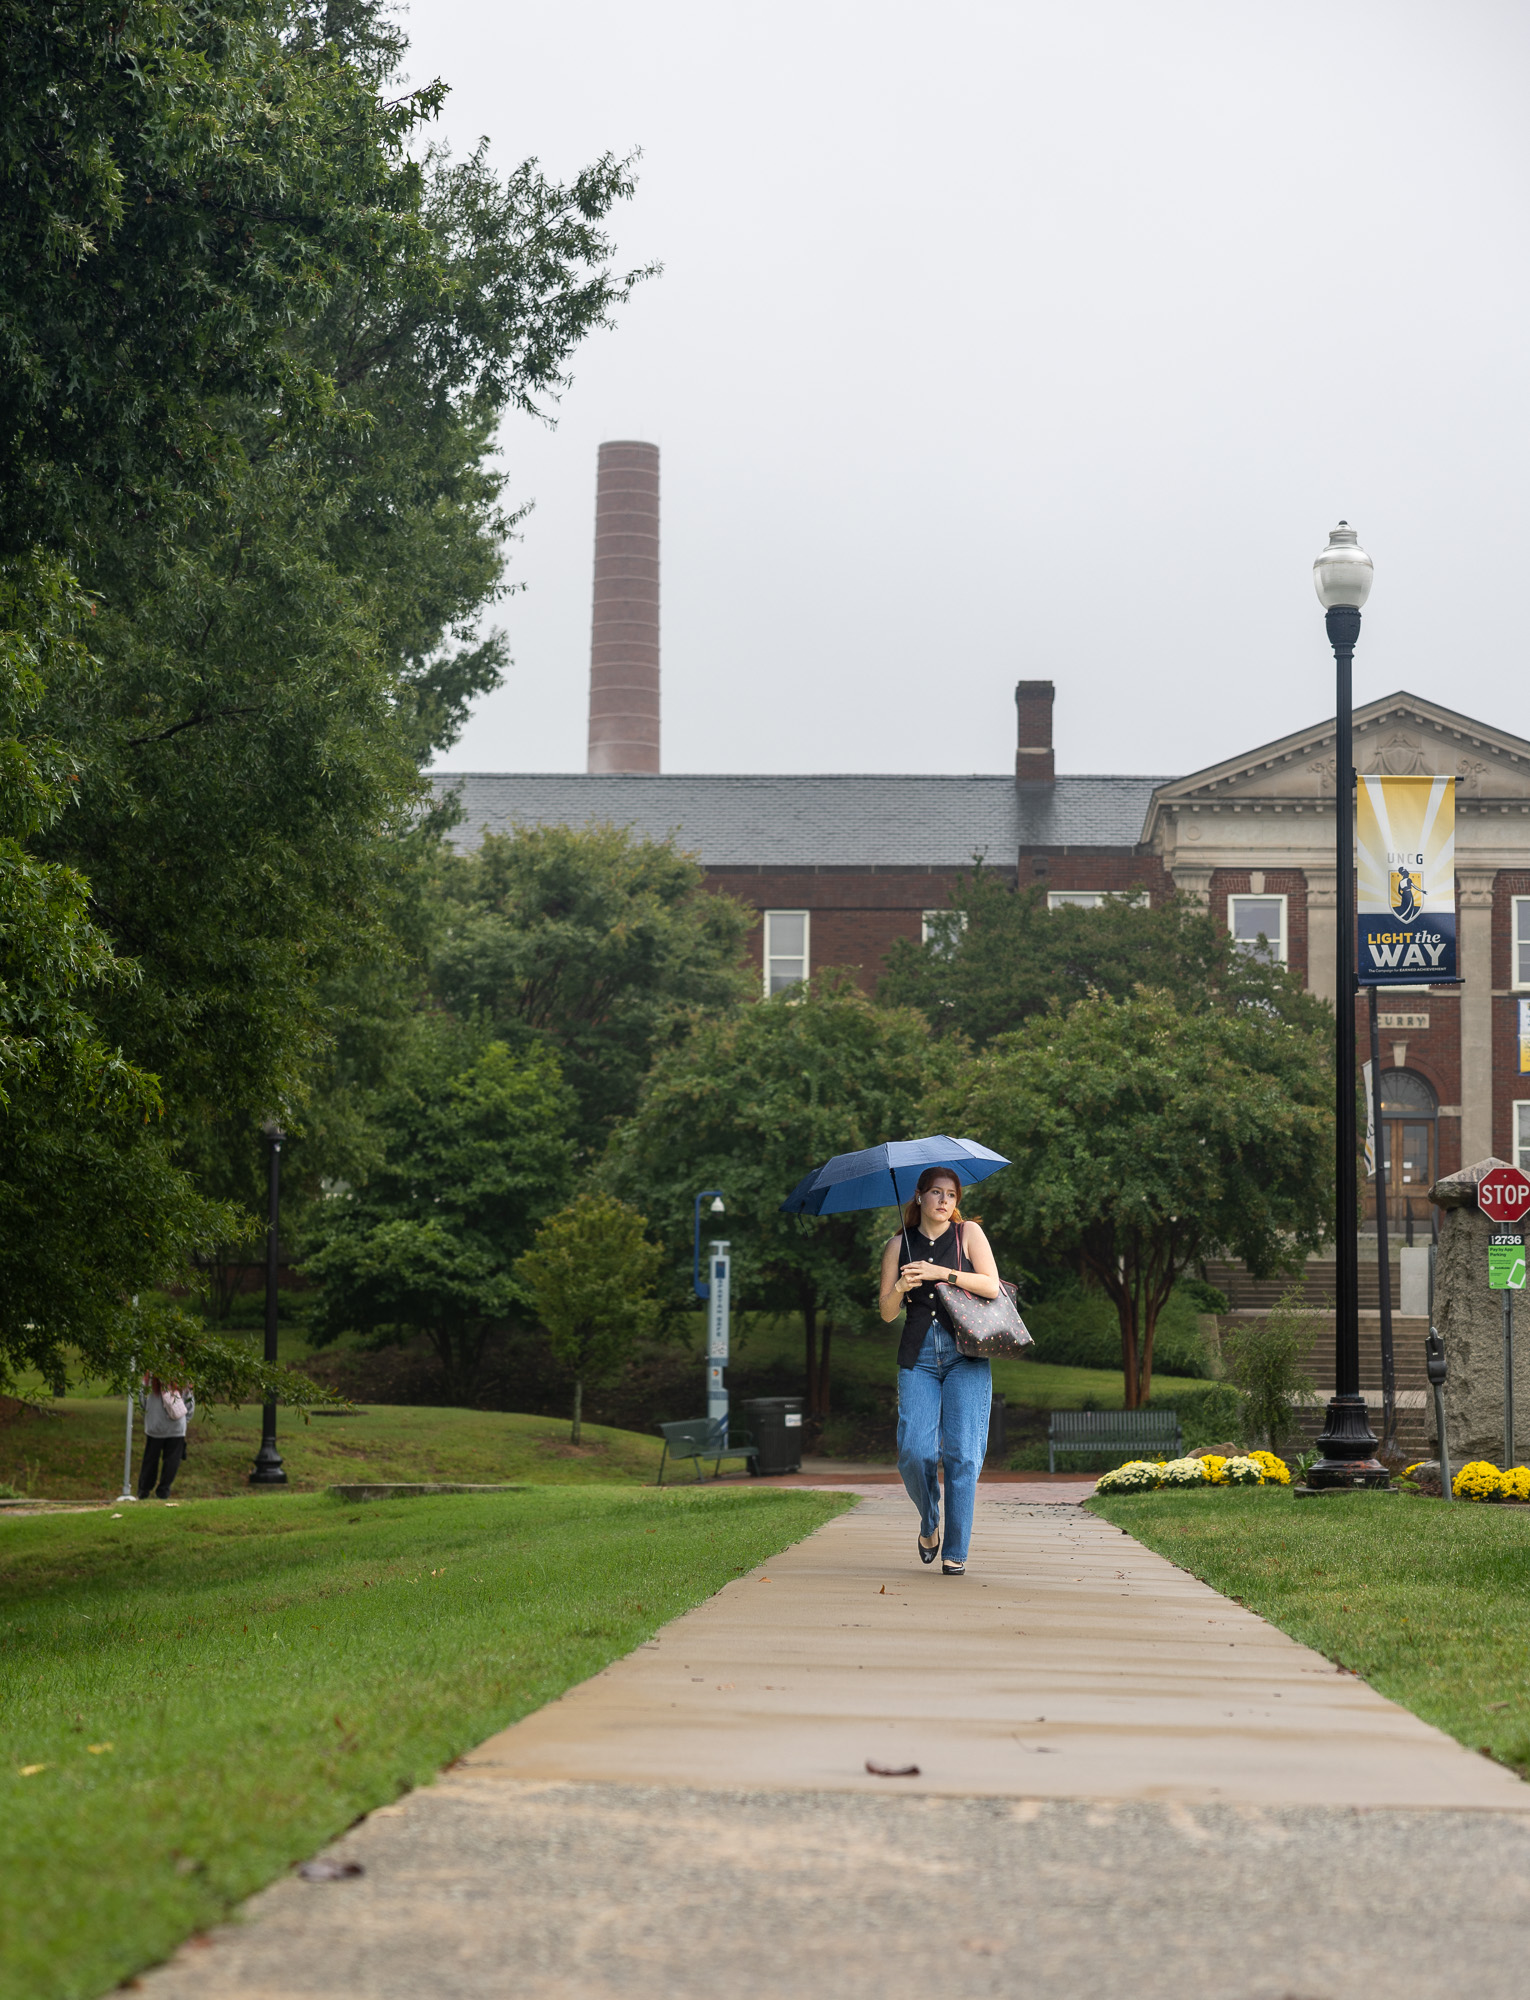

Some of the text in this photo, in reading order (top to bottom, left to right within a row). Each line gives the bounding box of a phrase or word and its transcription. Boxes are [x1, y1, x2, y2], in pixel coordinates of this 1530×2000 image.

[1387, 853, 1423, 865] UNCG
[1368, 930, 1441, 944] LIGHT the
[1368, 943, 1447, 967] WAY
[1481, 1184, 1530, 1205] STOP
[1494, 1235, 1522, 1245] 2736
